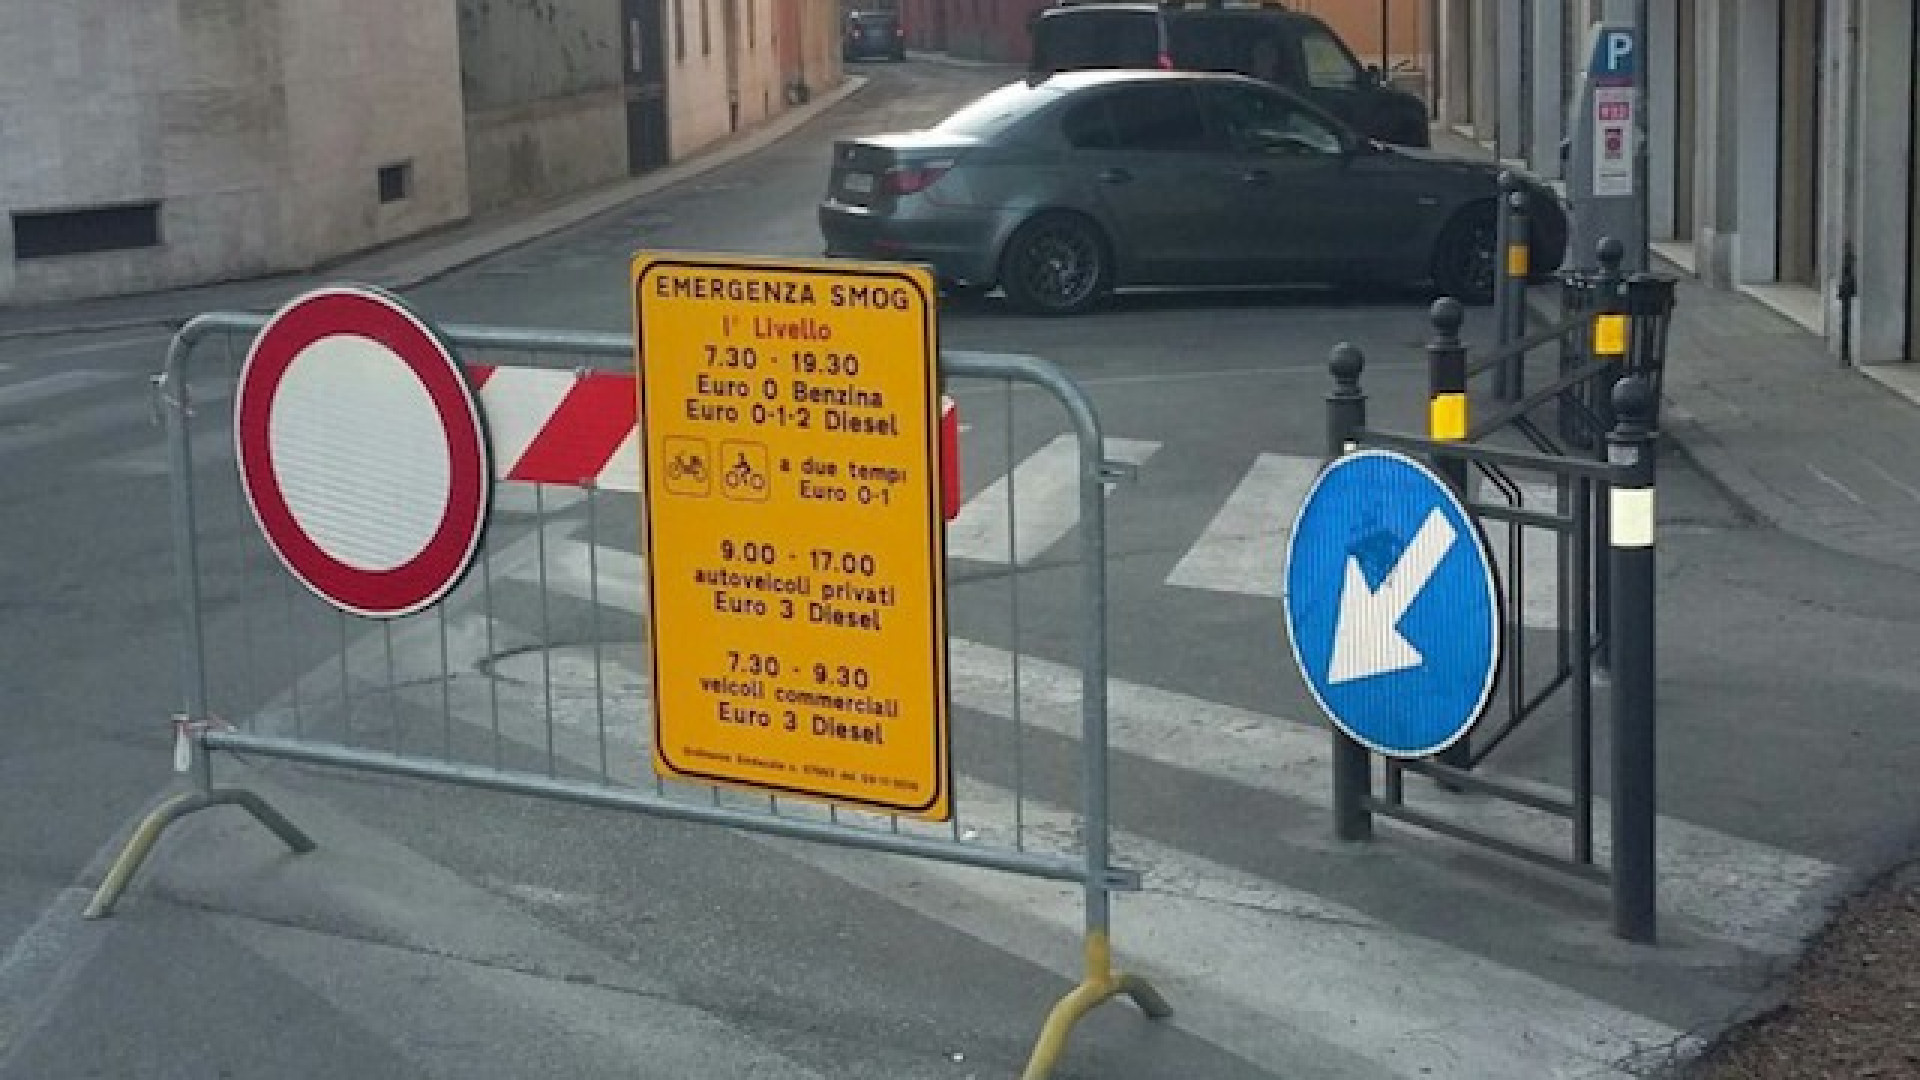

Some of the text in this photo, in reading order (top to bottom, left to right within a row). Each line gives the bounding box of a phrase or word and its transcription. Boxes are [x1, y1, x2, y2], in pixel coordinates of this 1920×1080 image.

[1607, 33, 1633, 70] P
[655, 275, 910, 311] EMERGENZA SMOG
[753, 316, 832, 341] Livello
[704, 345, 757, 370] 7.30
[791, 351, 859, 376] 19.30
[697, 374, 883, 408] Euro 0 Benzina
[686, 398, 899, 436] Euro 0-1-2 Diesel
[779, 457, 791, 472] a
[801, 455, 838, 476] due
[799, 479, 890, 506] Euro 0-1
[720, 539, 775, 565] 9.00
[810, 548, 875, 577] 17.00
[693, 568, 896, 607] autoveicoli privati
[713, 590, 883, 632] Euro 3 Diesel
[726, 650, 780, 678] 7.30
[812, 662, 869, 690] 9.30
[699, 675, 899, 717] veicoli commerciali
[718, 701, 885, 745] Euro 3 Diesel
